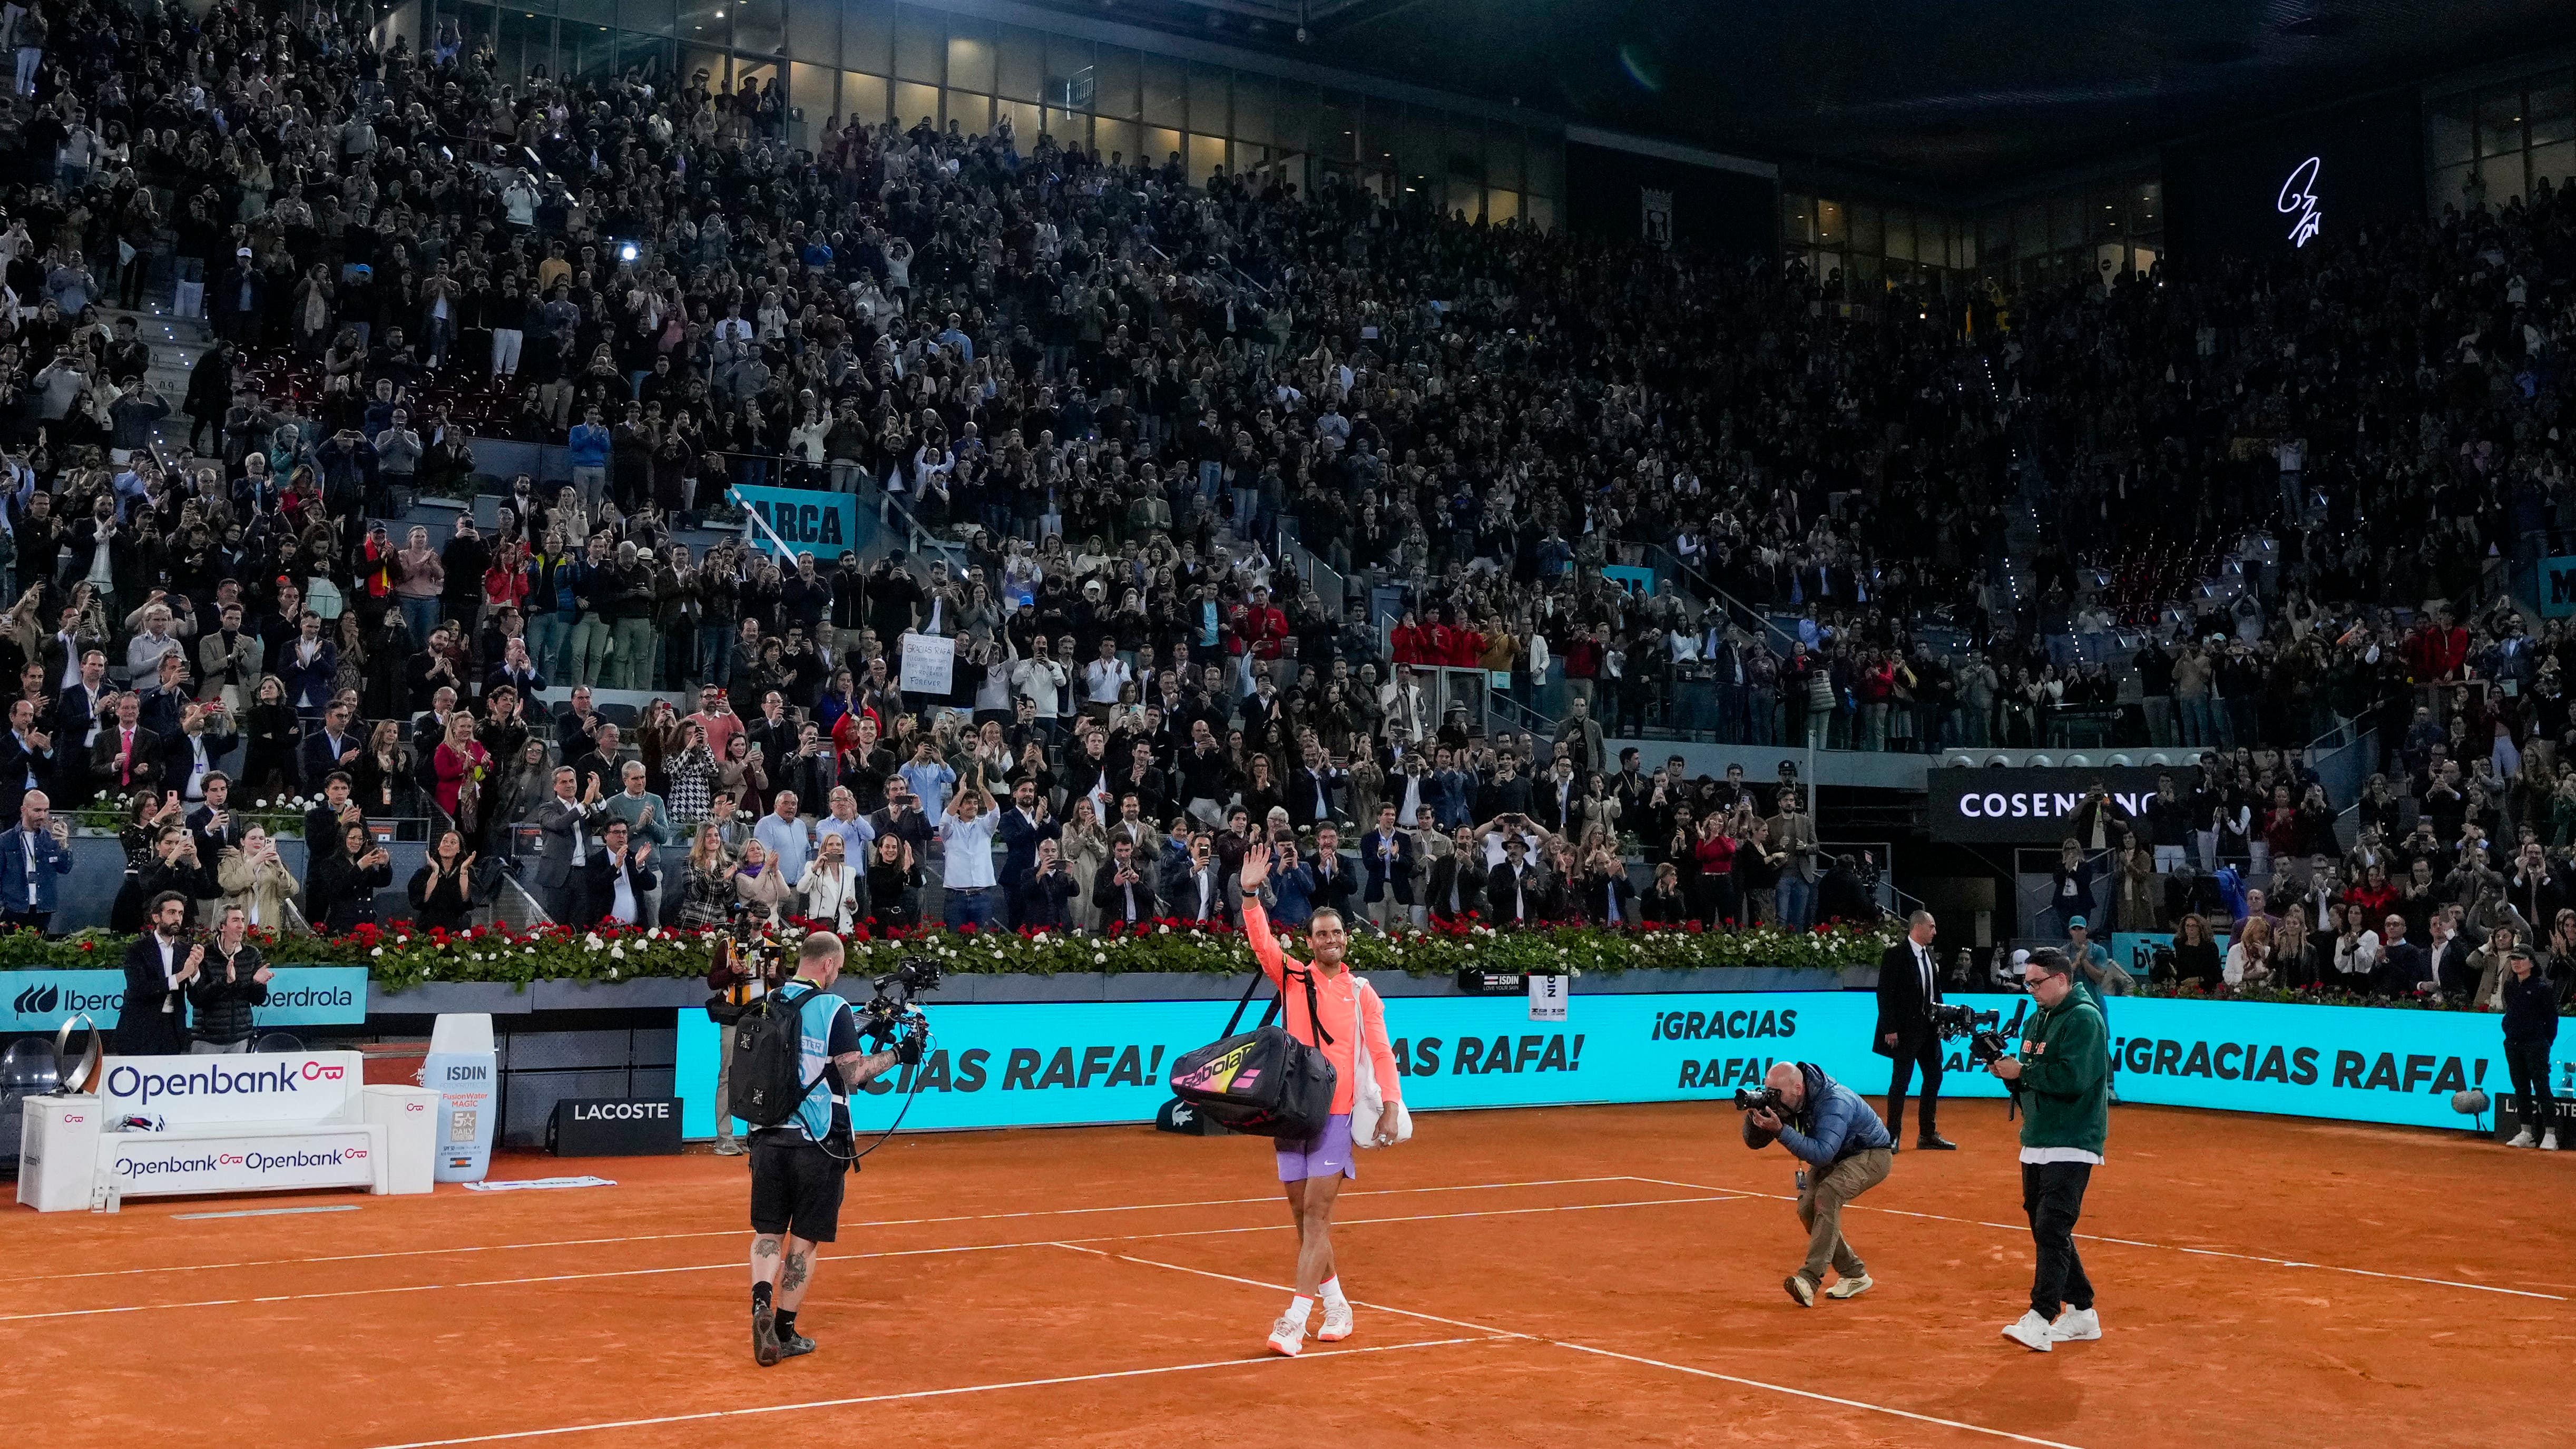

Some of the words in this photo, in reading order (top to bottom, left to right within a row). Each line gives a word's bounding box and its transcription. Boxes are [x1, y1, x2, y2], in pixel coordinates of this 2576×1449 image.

[737, 500, 843, 545] ARCA
[906, 644, 932, 654] GRACIAS
[1499, 975, 1519, 985] ISDIN
[1002, 1045, 1165, 1091] RAFA!
[1452, 1034, 1585, 1075] RAFA!
[2333, 1049, 2489, 1094] RAFA!
[108, 1061, 298, 1105] Openbank
[447, 1066, 486, 1081] ISDIN
[575, 1103, 669, 1121] LACOSTE
[116, 1154, 217, 1179] Openbank
[246, 1148, 342, 1173] Openbank
